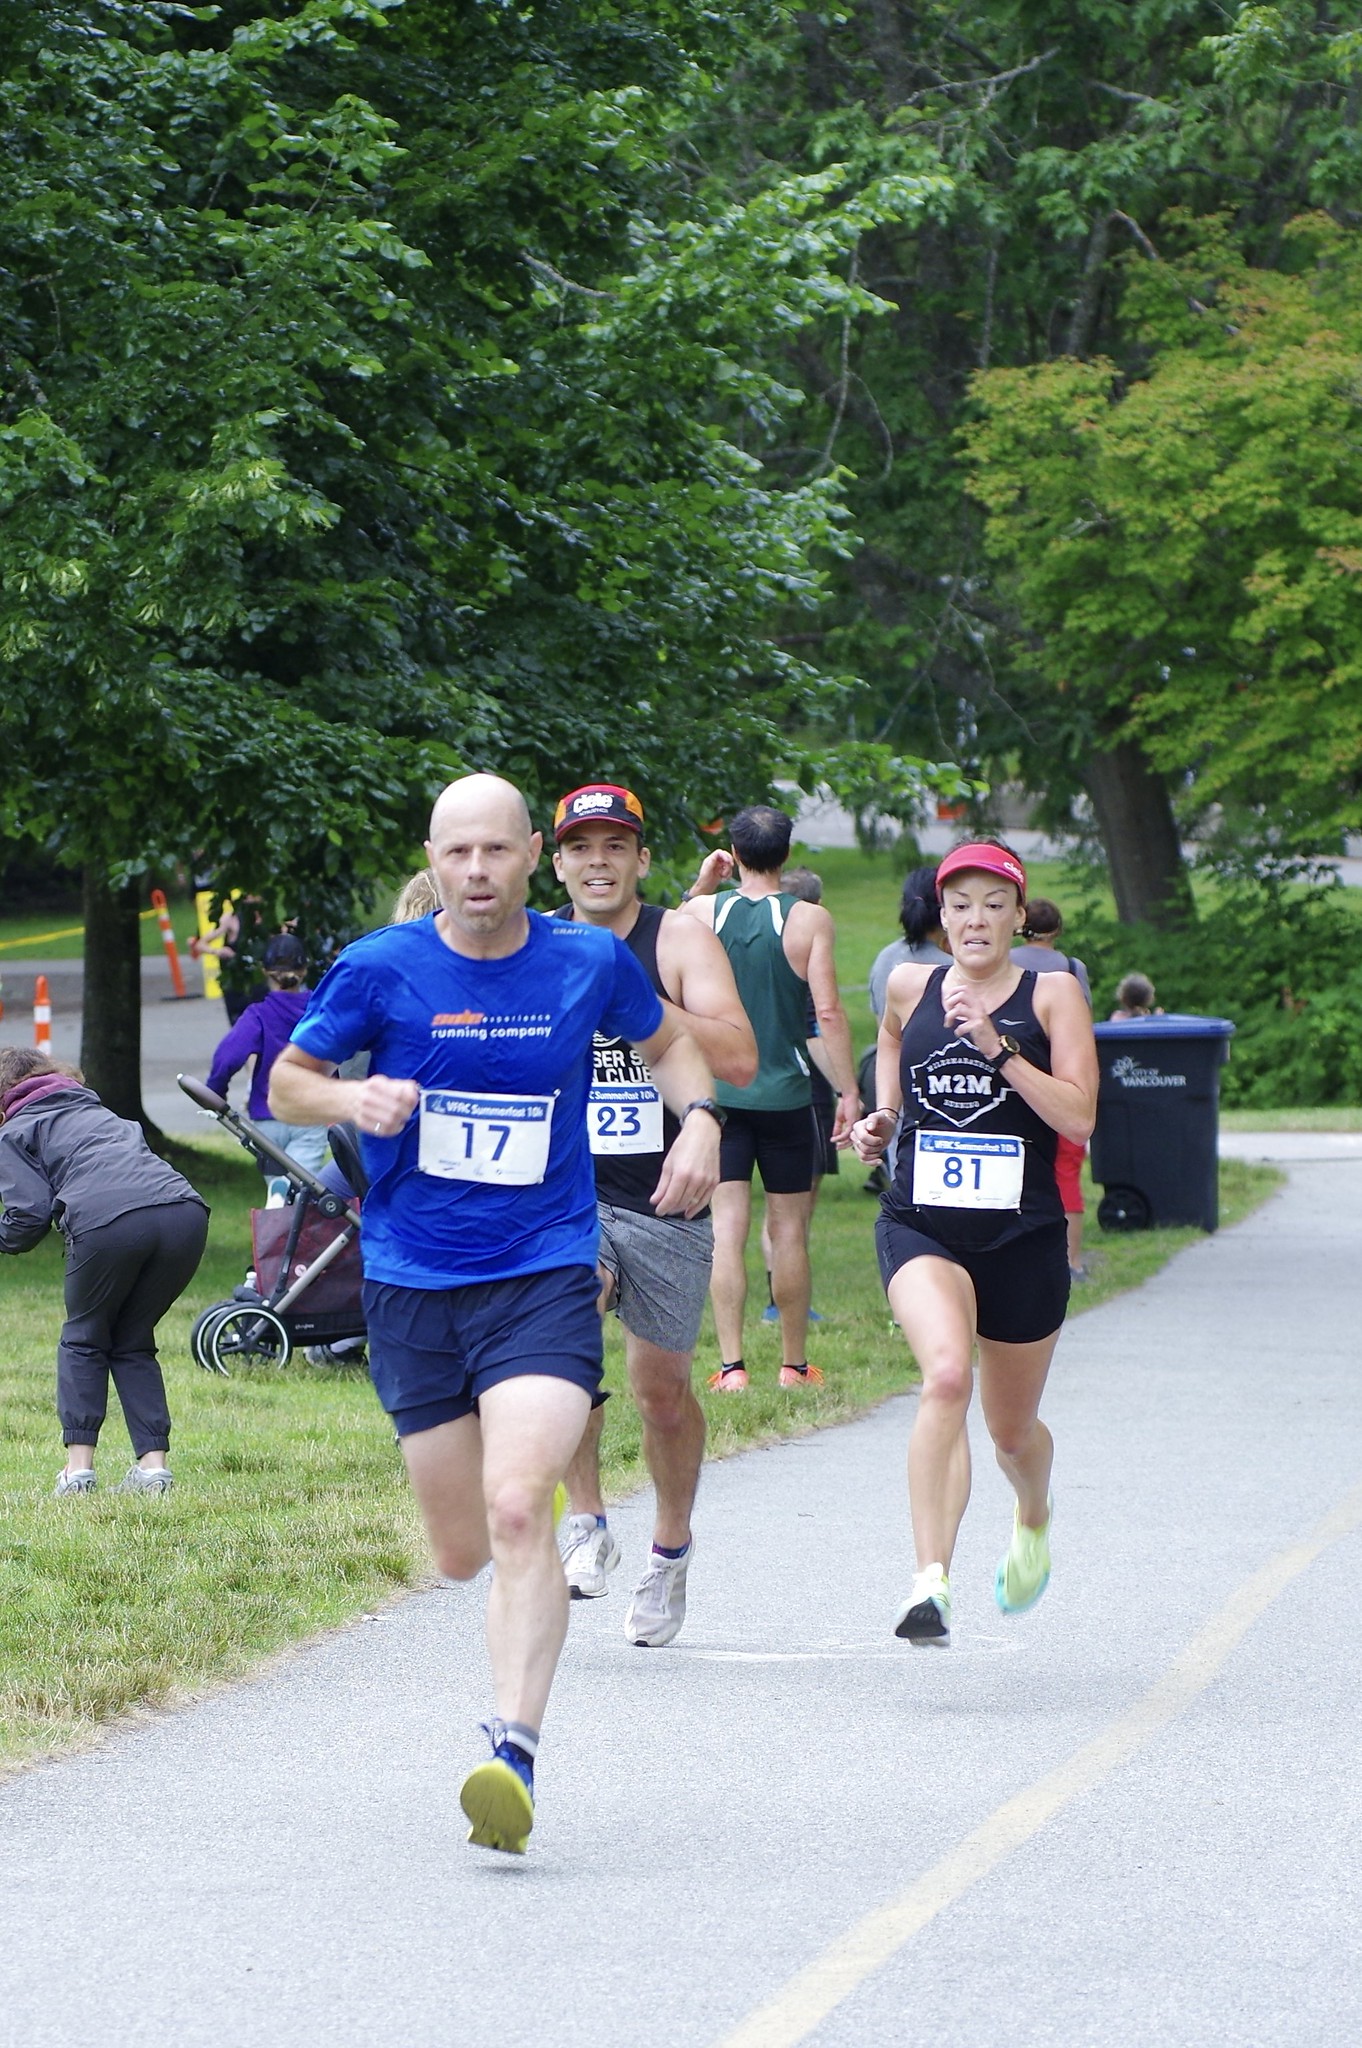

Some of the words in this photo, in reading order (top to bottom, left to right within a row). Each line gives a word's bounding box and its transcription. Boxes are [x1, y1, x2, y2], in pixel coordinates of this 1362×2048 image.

[431, 1025, 488, 1041] running
[489, 1026, 552, 1040] company
[927, 1074, 993, 1095] M2M
[1121, 1075, 1187, 1088] VANCOUVER
[597, 1105, 641, 1137] 23
[461, 1121, 511, 1162] 17
[943, 1156, 981, 1190] 81
